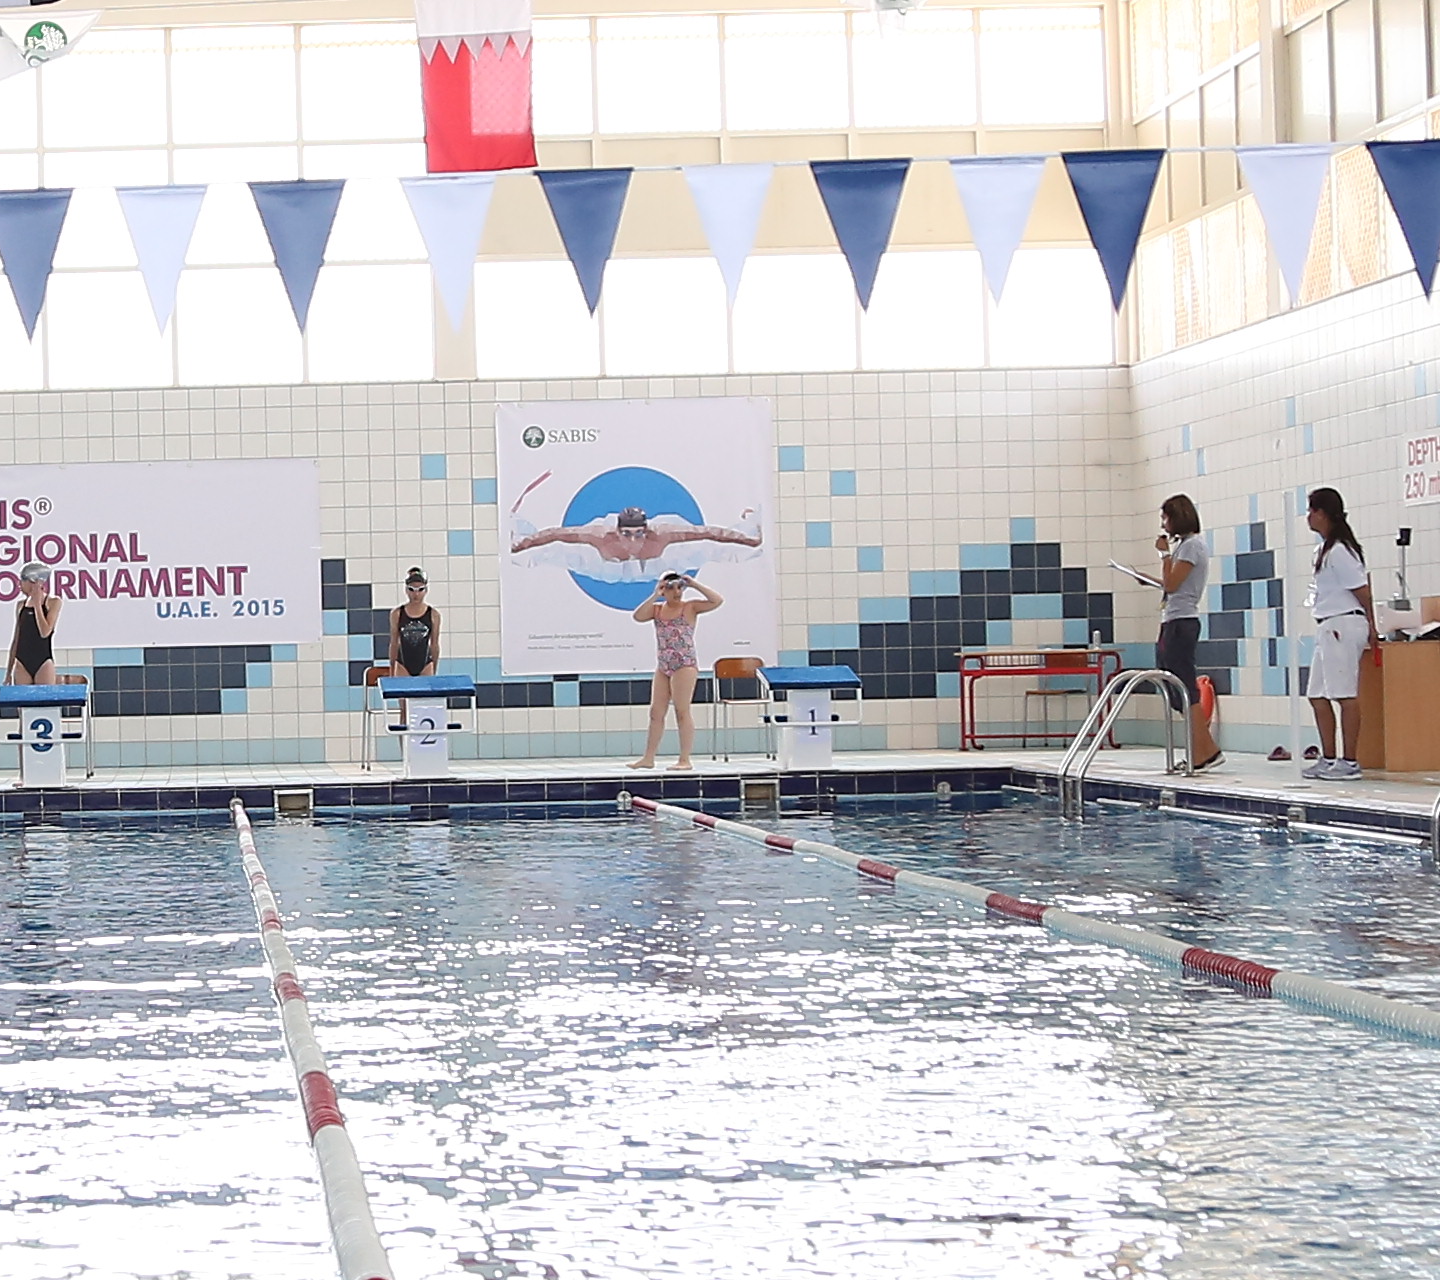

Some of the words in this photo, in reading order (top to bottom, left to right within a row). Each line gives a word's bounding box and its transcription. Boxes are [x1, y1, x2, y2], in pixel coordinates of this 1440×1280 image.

[1404, 470, 1426, 499] 2.50
[156, 600, 219, 619] U.A.E.
[231, 598, 285, 617] 2015
[30, 718, 54, 753] 3
[420, 718, 438, 745] 2
[809, 708, 819, 736] 1
